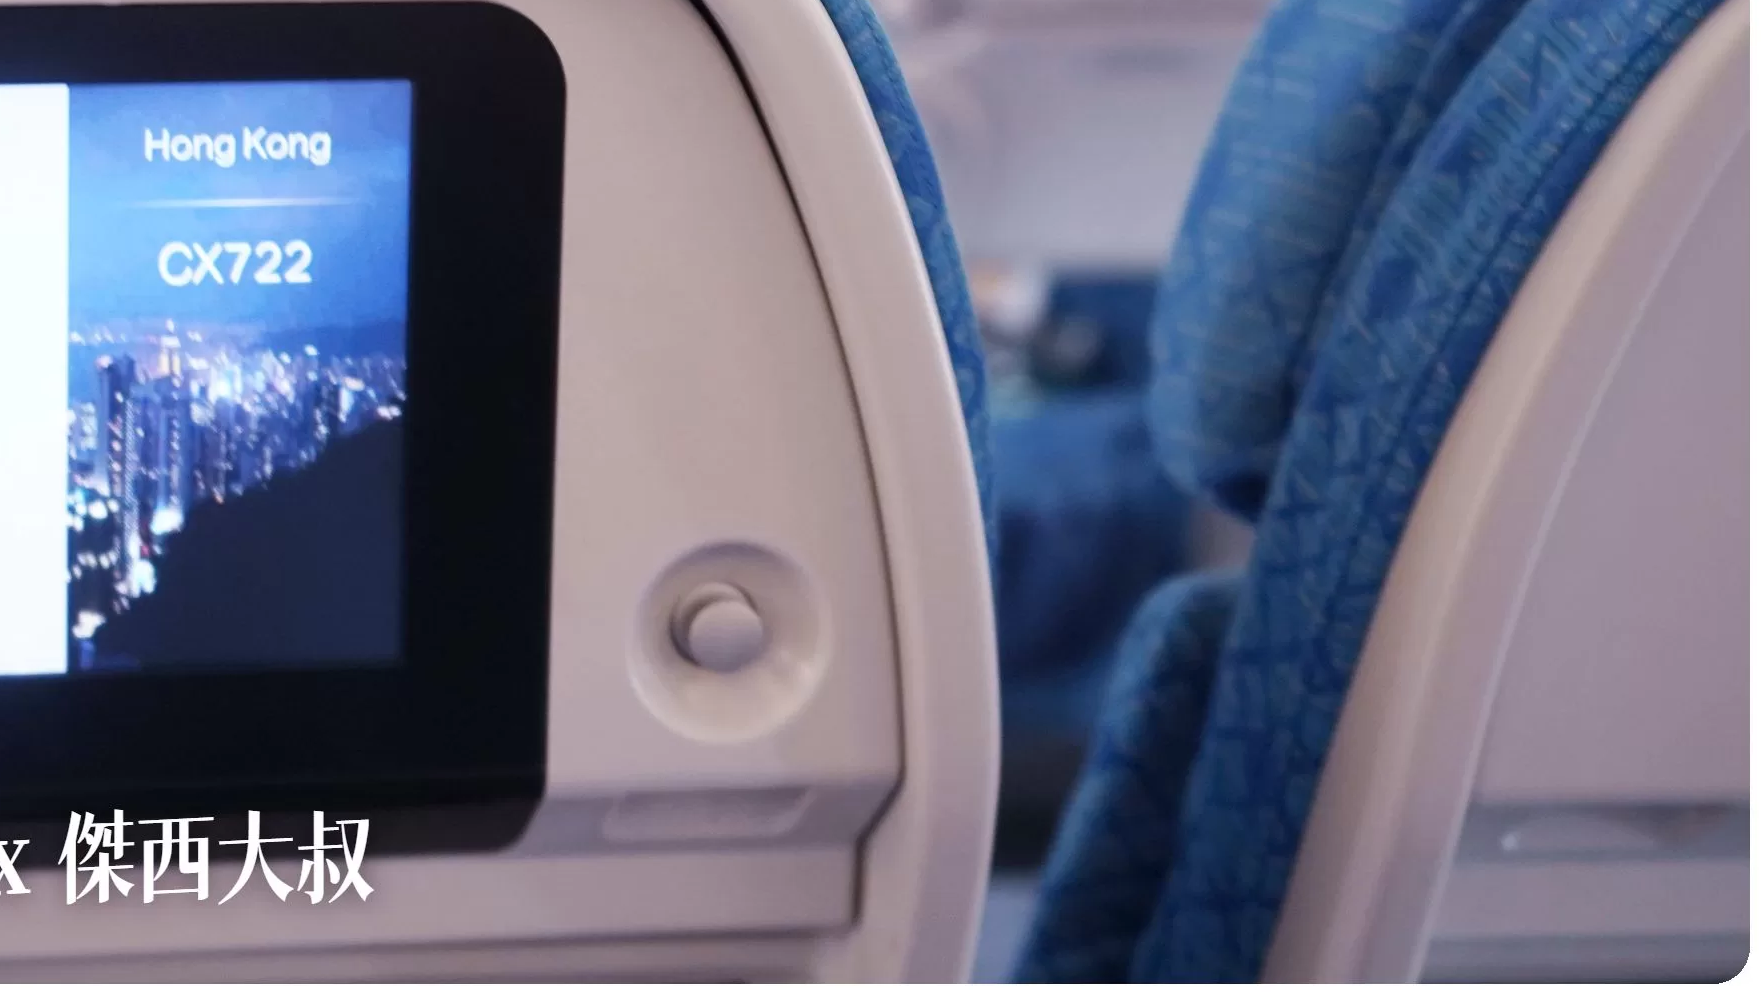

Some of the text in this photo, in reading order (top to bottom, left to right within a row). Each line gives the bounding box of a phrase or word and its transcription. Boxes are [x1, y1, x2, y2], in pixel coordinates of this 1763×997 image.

[144, 125, 332, 168] Hong Kong
[157, 240, 314, 287] CX722
